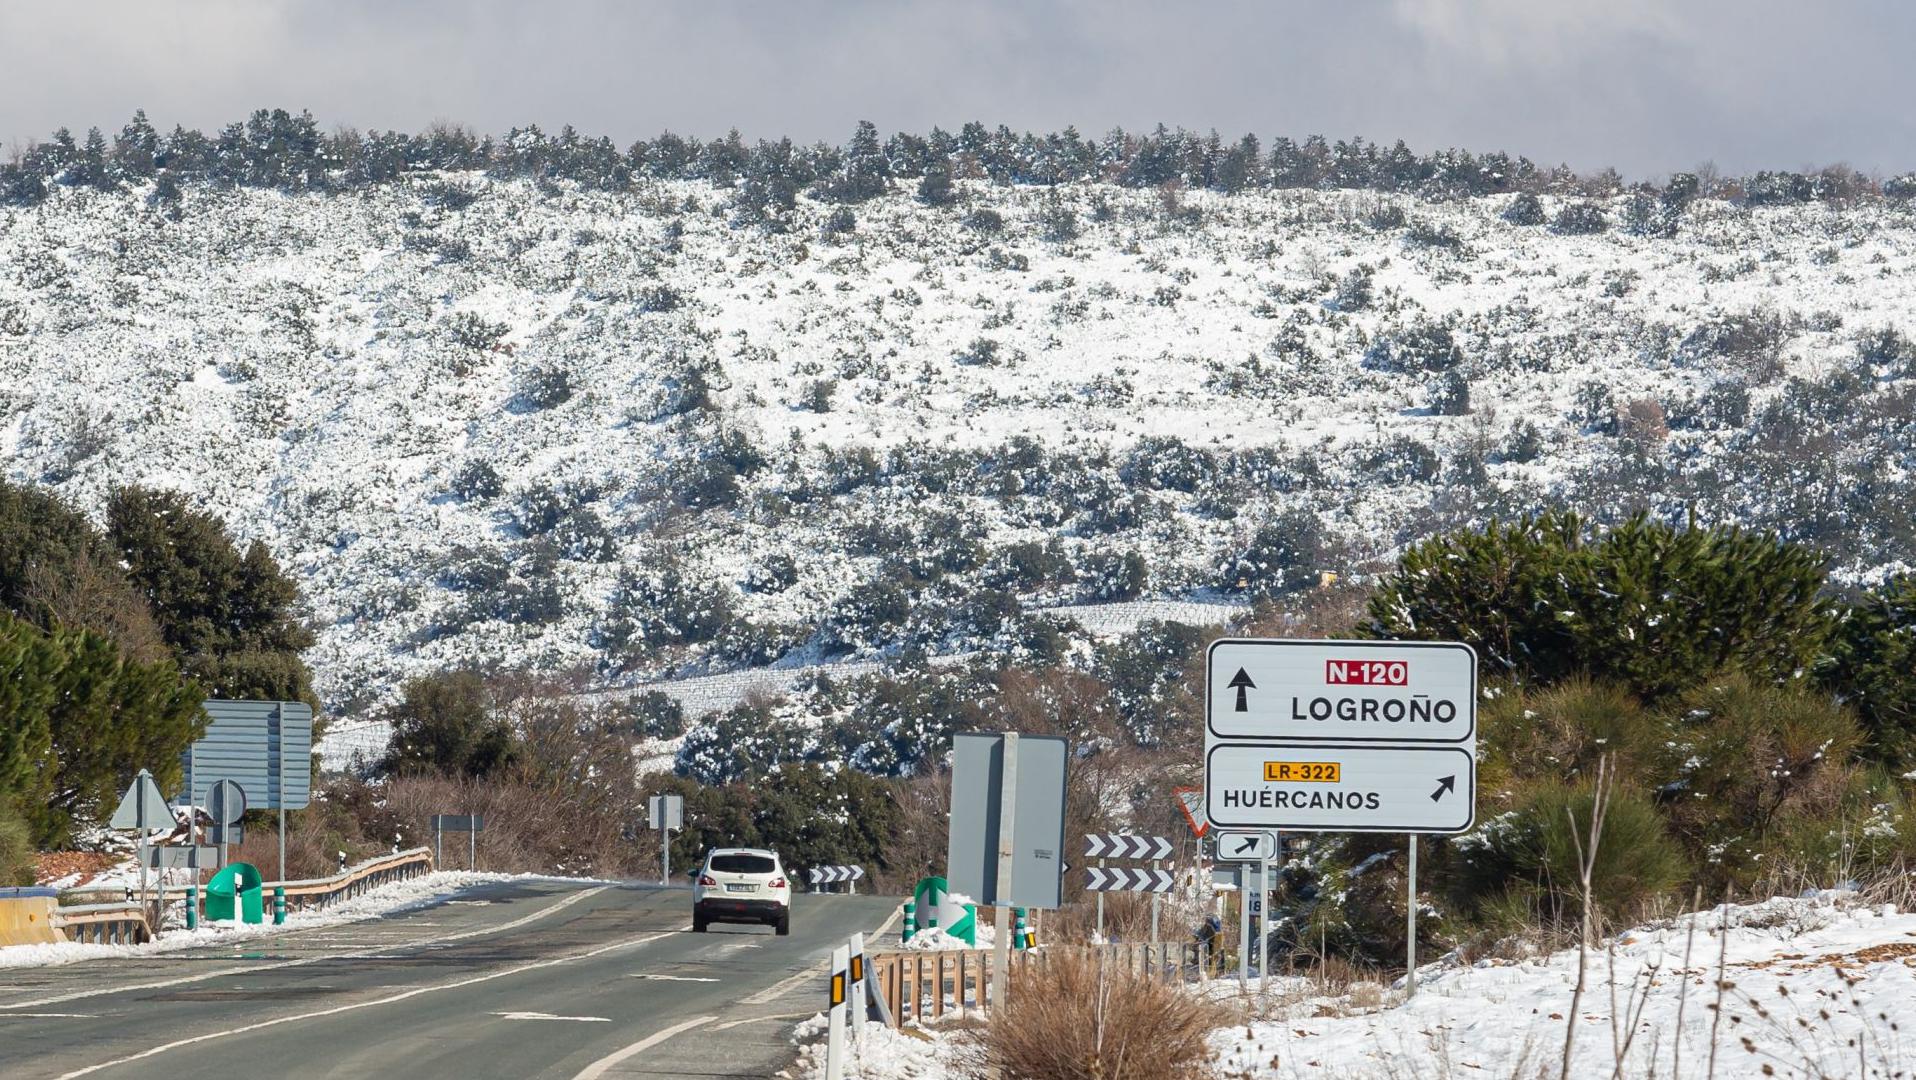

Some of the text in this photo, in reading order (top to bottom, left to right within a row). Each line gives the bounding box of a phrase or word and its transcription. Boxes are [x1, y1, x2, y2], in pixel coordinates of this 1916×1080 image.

[1328, 662, 1406, 684] N-120
[1292, 694, 1457, 723] LOGROÑO
[1267, 764, 1336, 780] LR-322
[1223, 785, 1380, 810] HUÉRCANOS
